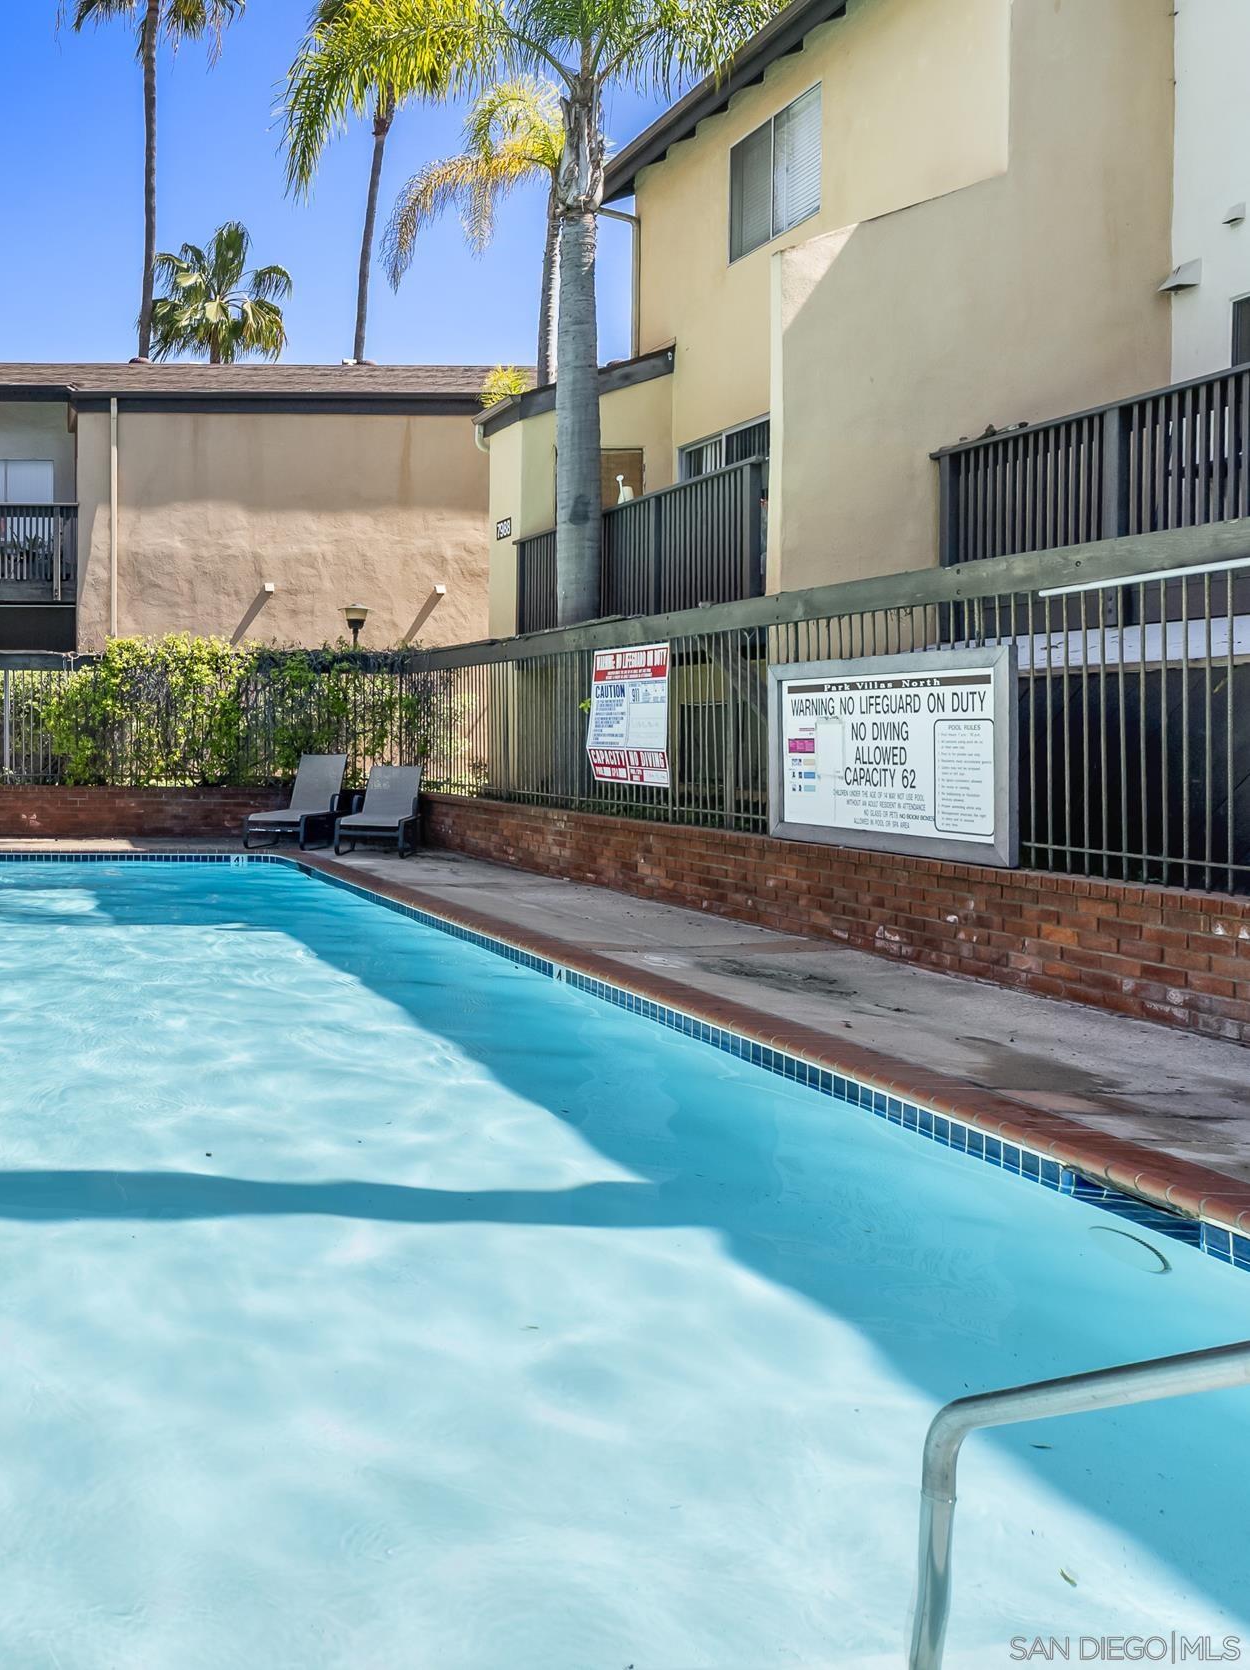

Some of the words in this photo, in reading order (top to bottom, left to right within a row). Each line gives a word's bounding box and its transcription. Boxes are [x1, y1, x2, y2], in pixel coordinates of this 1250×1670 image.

[595, 684, 626, 699] CAUTION
[824, 683, 851, 692] Park
[856, 681, 893, 690] Villas
[901, 678, 941, 688] North
[631, 688, 640, 702] 911
[790, 697, 835, 717] WARNING
[840, 696, 855, 715] NO
[859, 694, 921, 714] LIFEGUARD
[927, 692, 945, 713] ON
[951, 690, 986, 712] DUTY
[851, 721, 867, 741] NO
[872, 721, 909, 741] DIVING
[590, 749, 626, 767] CAPACITY
[628, 751, 639, 767] NO
[639, 751, 665, 768] DIVING
[855, 746, 907, 765] ALLOWED
[844, 767, 896, 788] CAPACITY
[902, 768, 916, 789] 62
